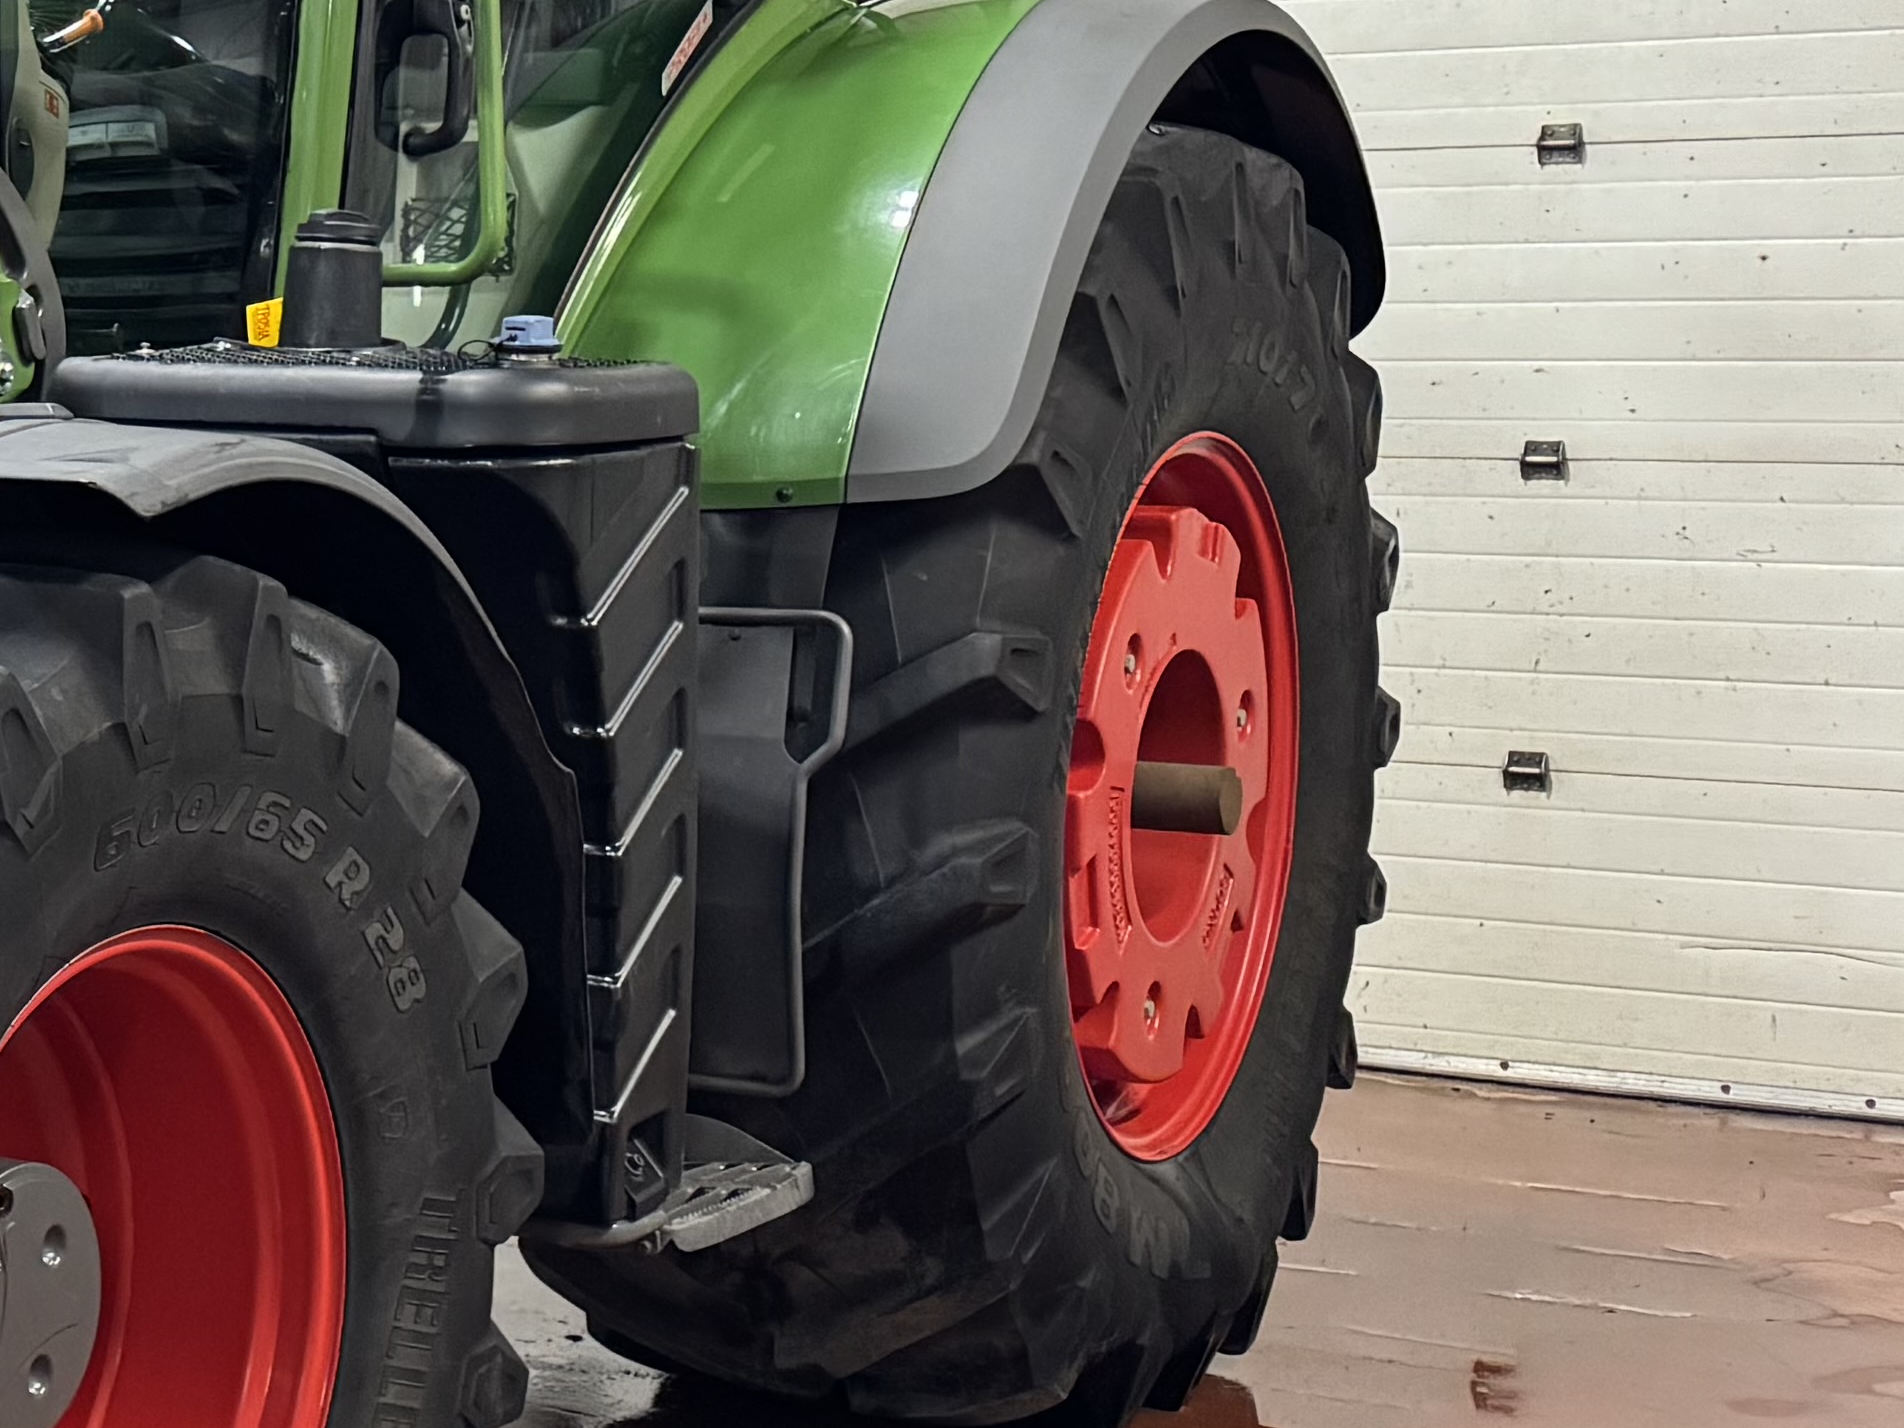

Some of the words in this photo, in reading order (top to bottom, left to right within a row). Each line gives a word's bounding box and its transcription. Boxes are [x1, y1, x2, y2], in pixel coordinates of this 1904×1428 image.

[93, 781, 330, 872] 600/65
[325, 846, 374, 912] R
[364, 906, 428, 1014] 28
